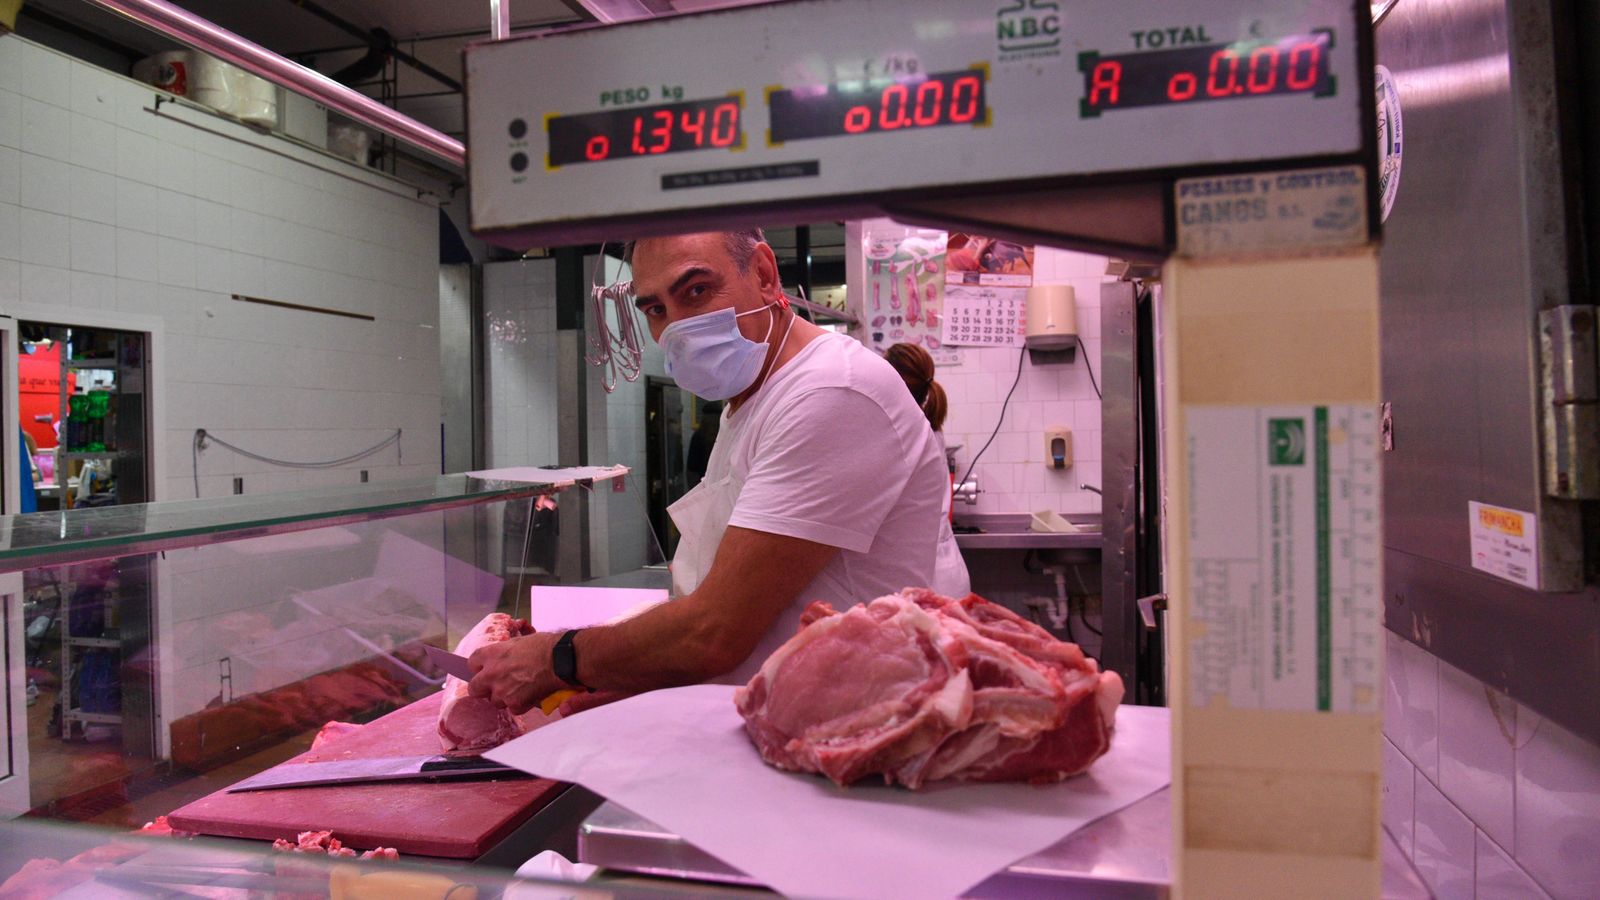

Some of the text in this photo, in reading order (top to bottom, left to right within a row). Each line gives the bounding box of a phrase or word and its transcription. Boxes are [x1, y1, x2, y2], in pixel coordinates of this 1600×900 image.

[1132, 25, 1211, 48] TOTAL
[1089, 61, 1122, 105] A
[600, 85, 684, 106] PESO kg
